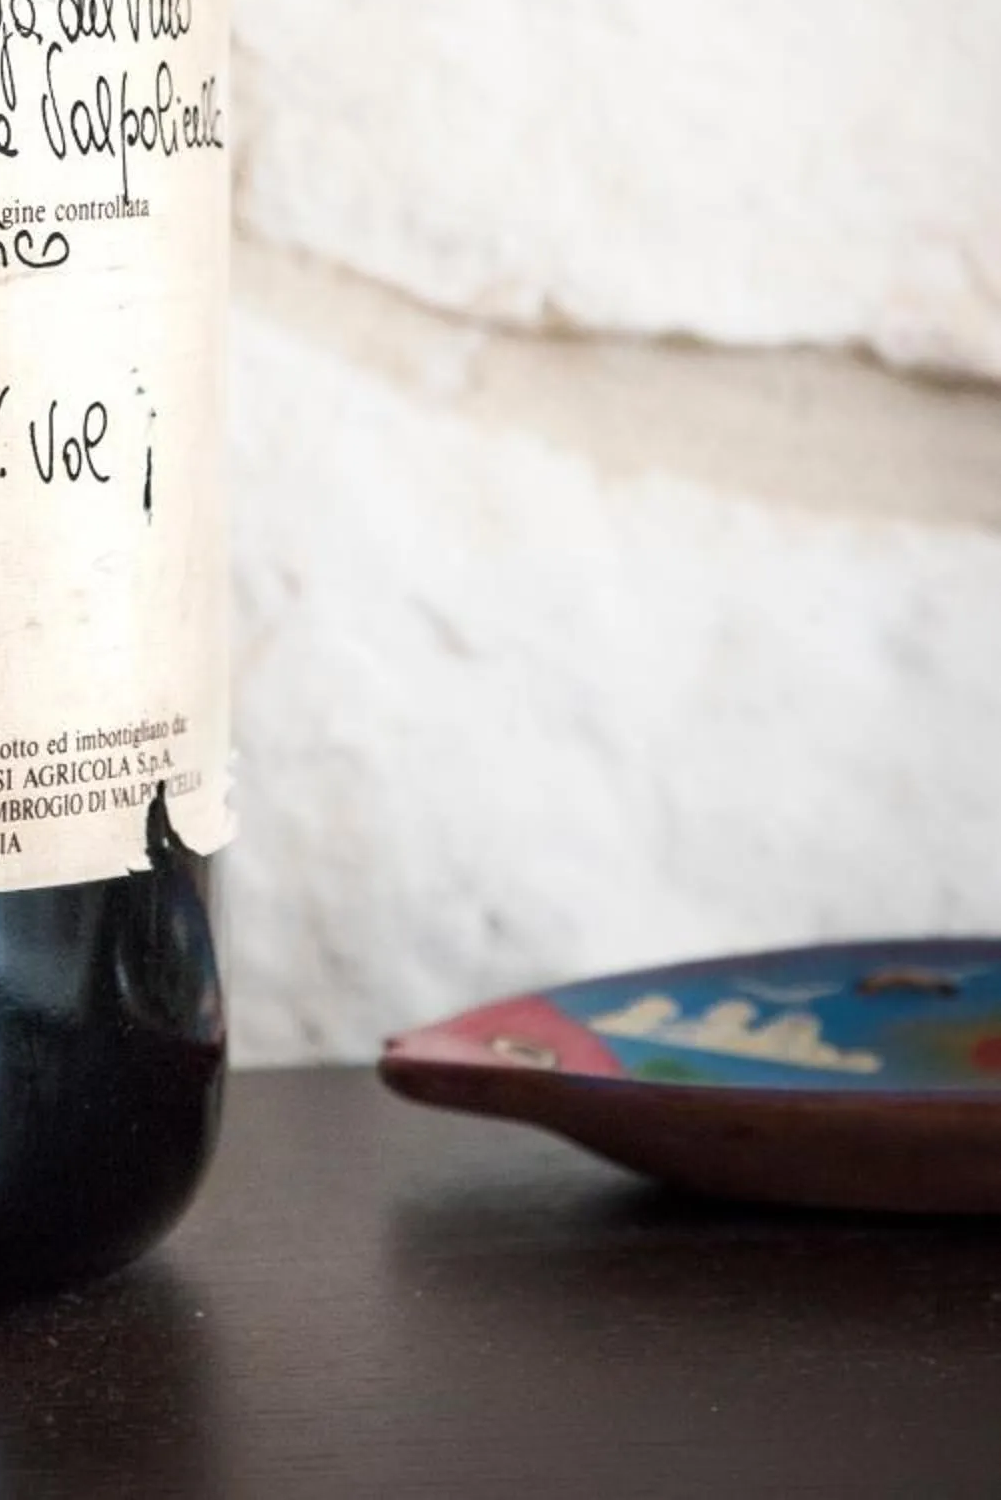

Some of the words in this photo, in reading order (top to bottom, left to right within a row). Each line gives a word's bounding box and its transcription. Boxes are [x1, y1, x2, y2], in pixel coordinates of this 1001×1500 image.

[53, 194, 150, 223] controllata
[46, 730, 68, 756] ed
[22, 755, 131, 790] AGRICOLA
[87, 788, 107, 813] DI
